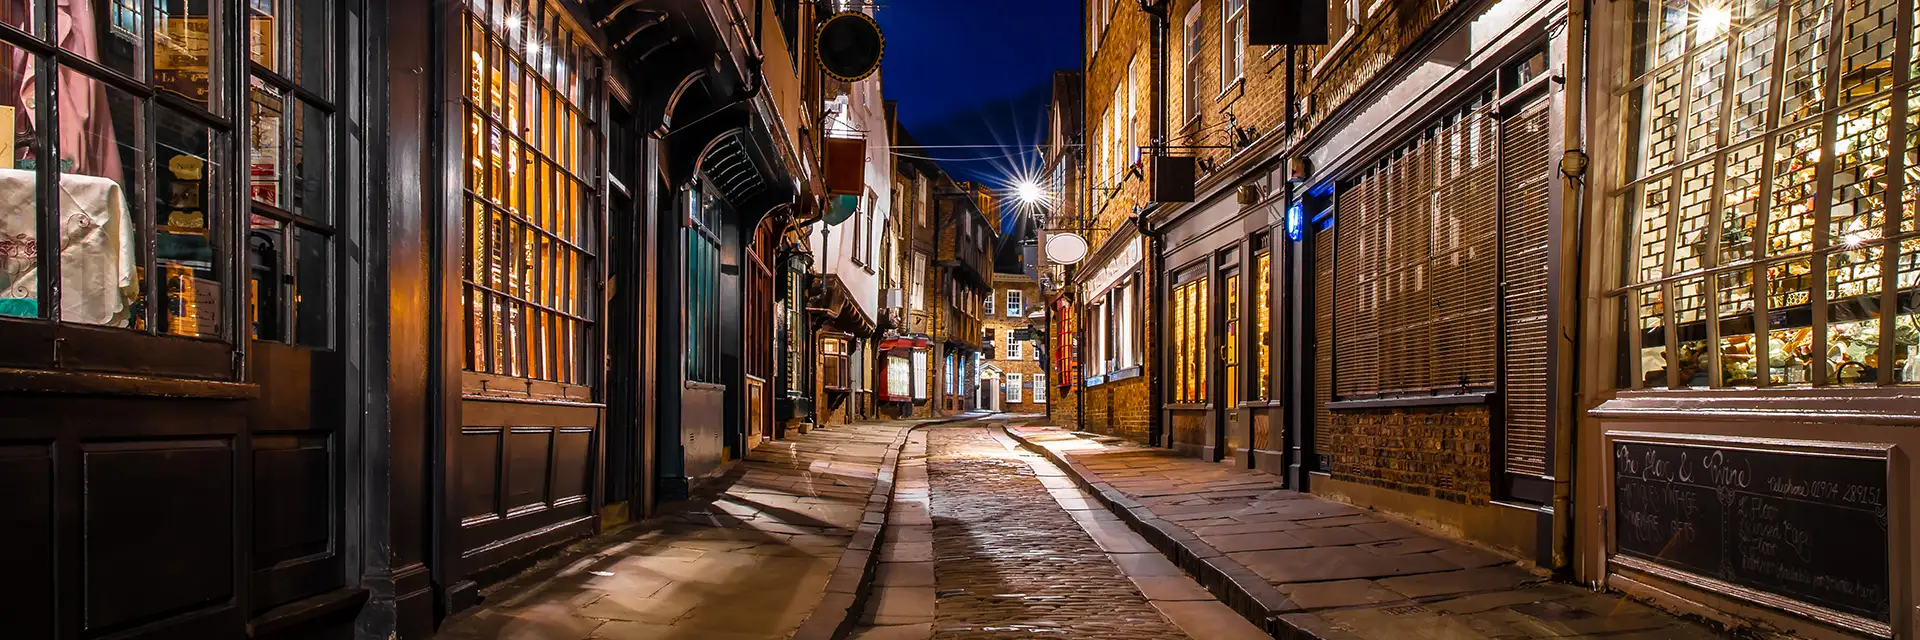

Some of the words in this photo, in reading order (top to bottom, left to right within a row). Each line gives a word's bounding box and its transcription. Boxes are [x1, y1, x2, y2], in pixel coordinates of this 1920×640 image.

[1617, 445, 1639, 474] The
[1679, 451, 1695, 483] &
[1767, 476, 1809, 498] Telephone
[1811, 480, 1839, 499] 01904
[1842, 484, 1882, 507] 289151
